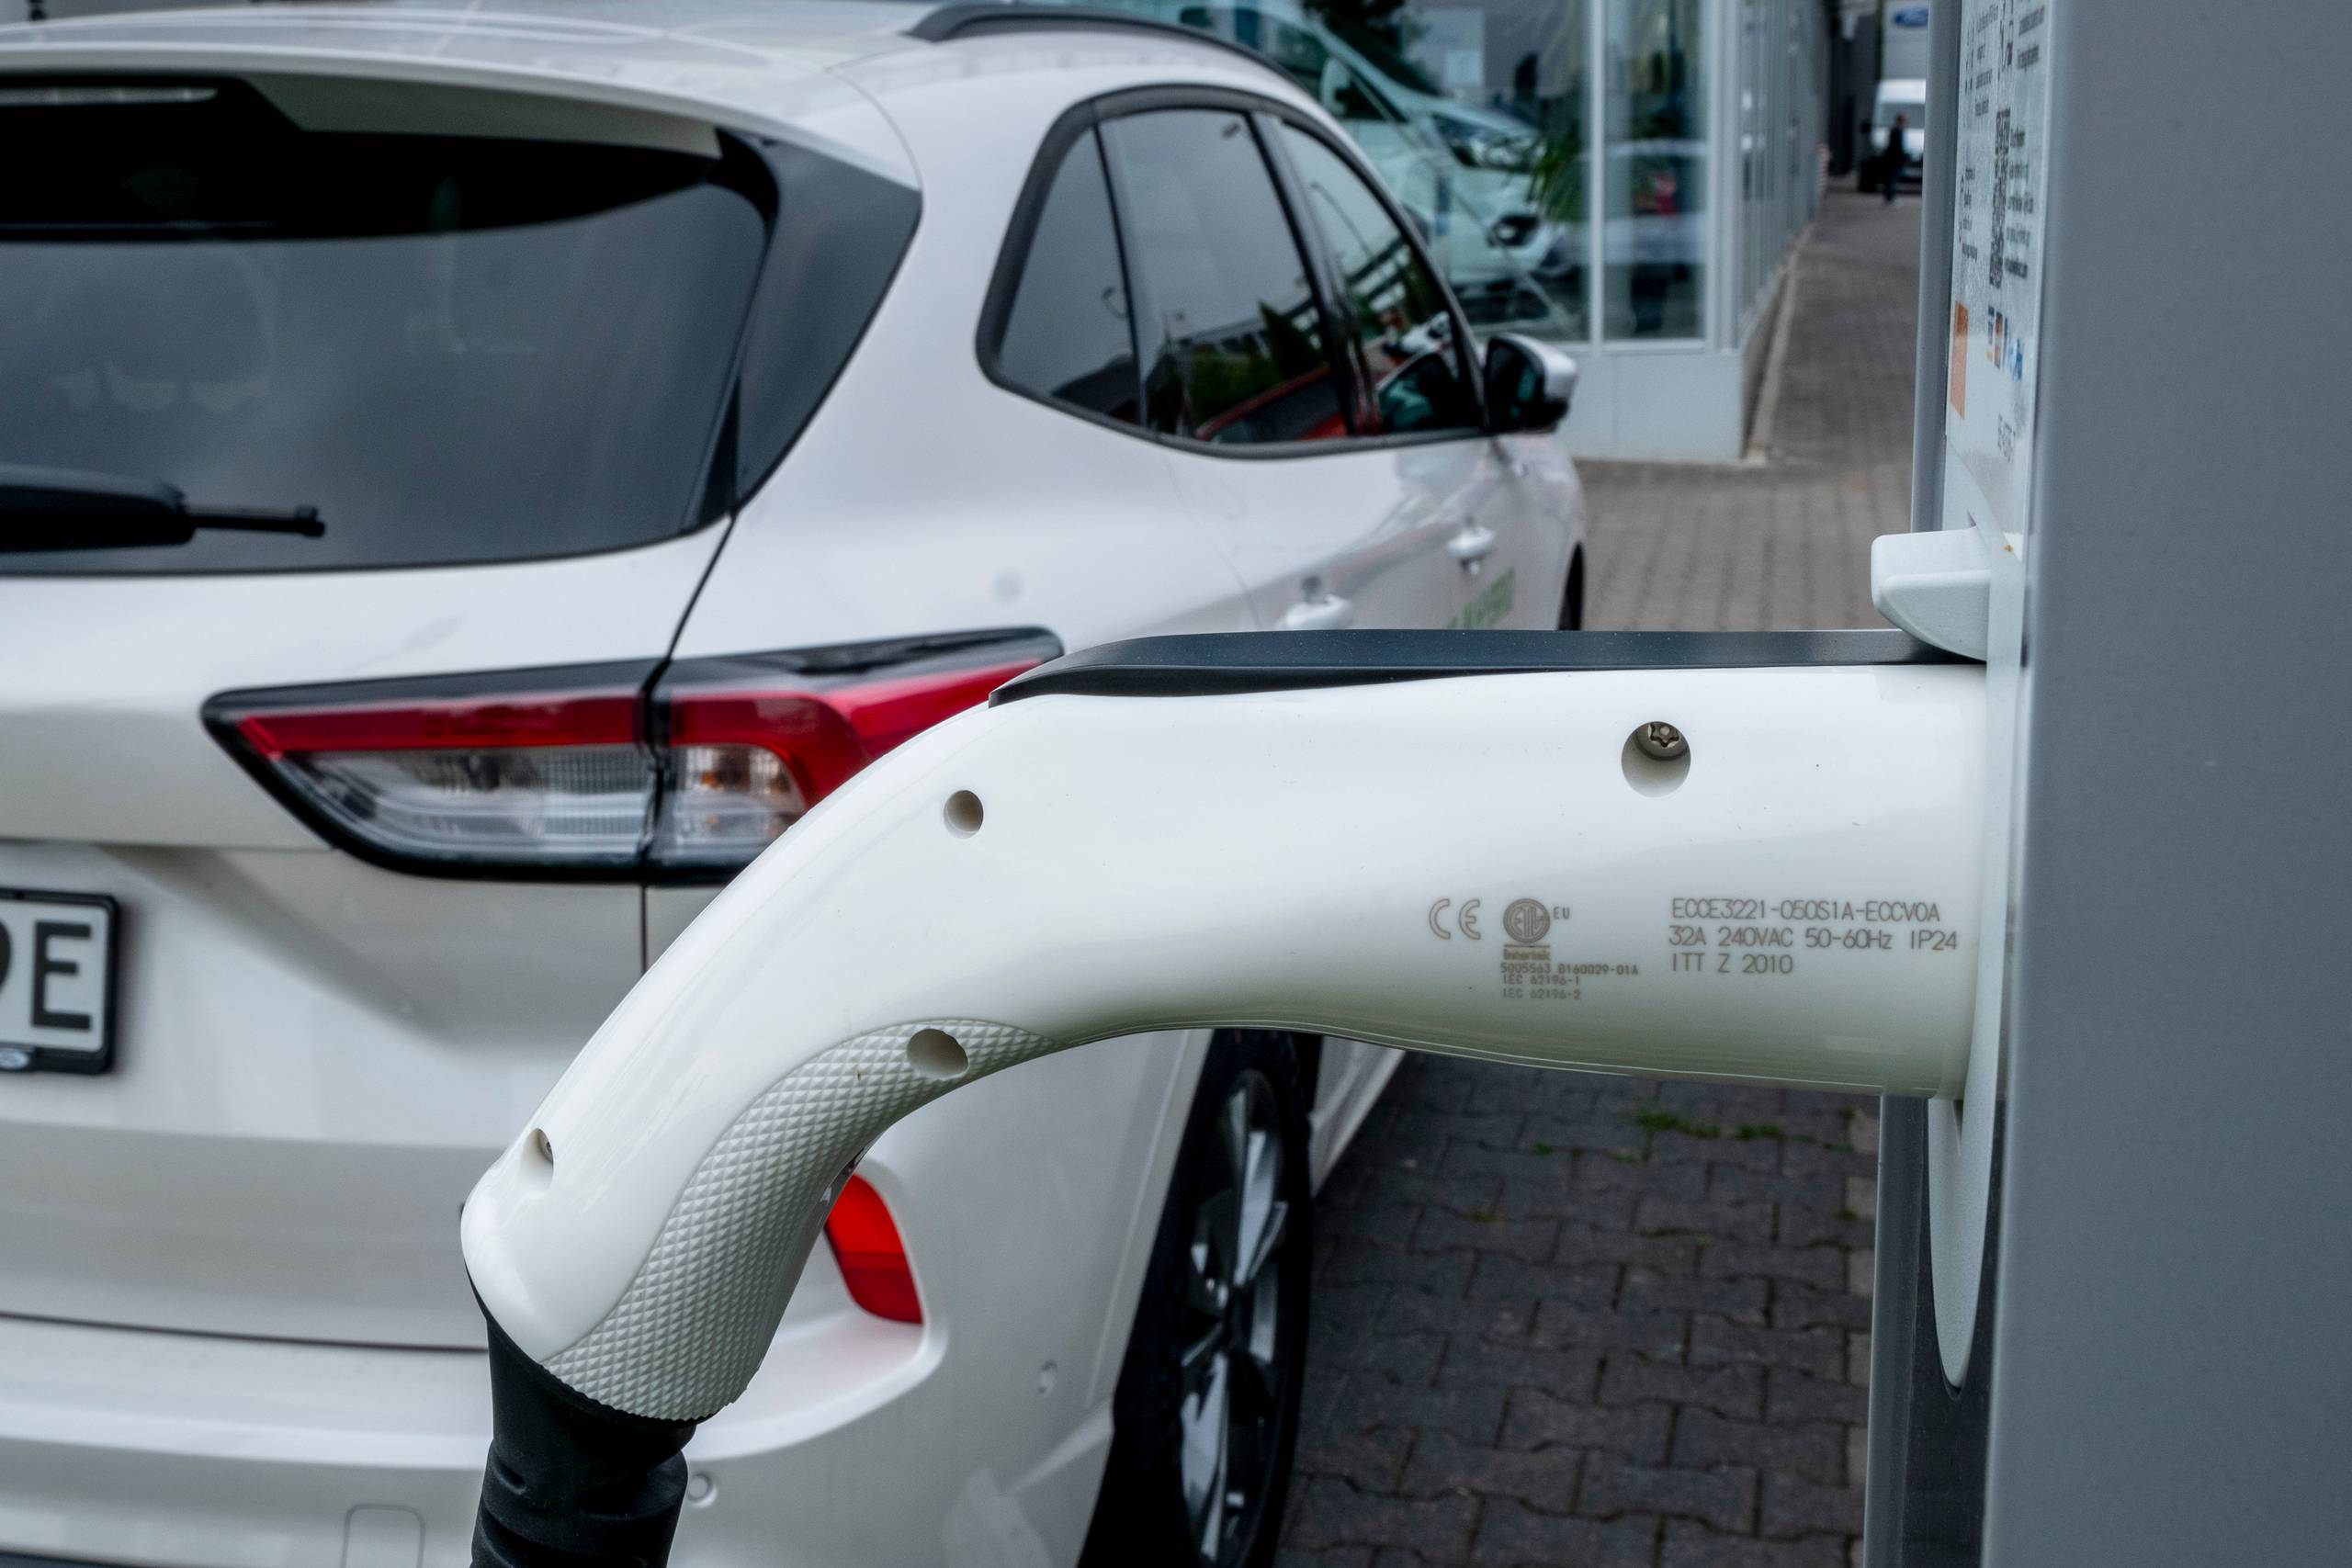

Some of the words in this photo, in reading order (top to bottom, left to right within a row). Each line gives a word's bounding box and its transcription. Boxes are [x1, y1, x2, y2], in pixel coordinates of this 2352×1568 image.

[1428, 897, 1482, 941] CE
[1553, 906, 1571, 919] EU
[1668, 925, 1707, 947] 32A
[1718, 926, 1793, 948] 240VAC
[1804, 928, 1893, 950] 50-60Hz
[1910, 930, 1958, 951] IP24
[1672, 953, 1706, 972] ITT
[1717, 953, 1731, 974] Z
[1742, 953, 1793, 975] 2010
[1503, 975, 1523, 986] IEC
[1530, 975, 1580, 987] 62196-1
